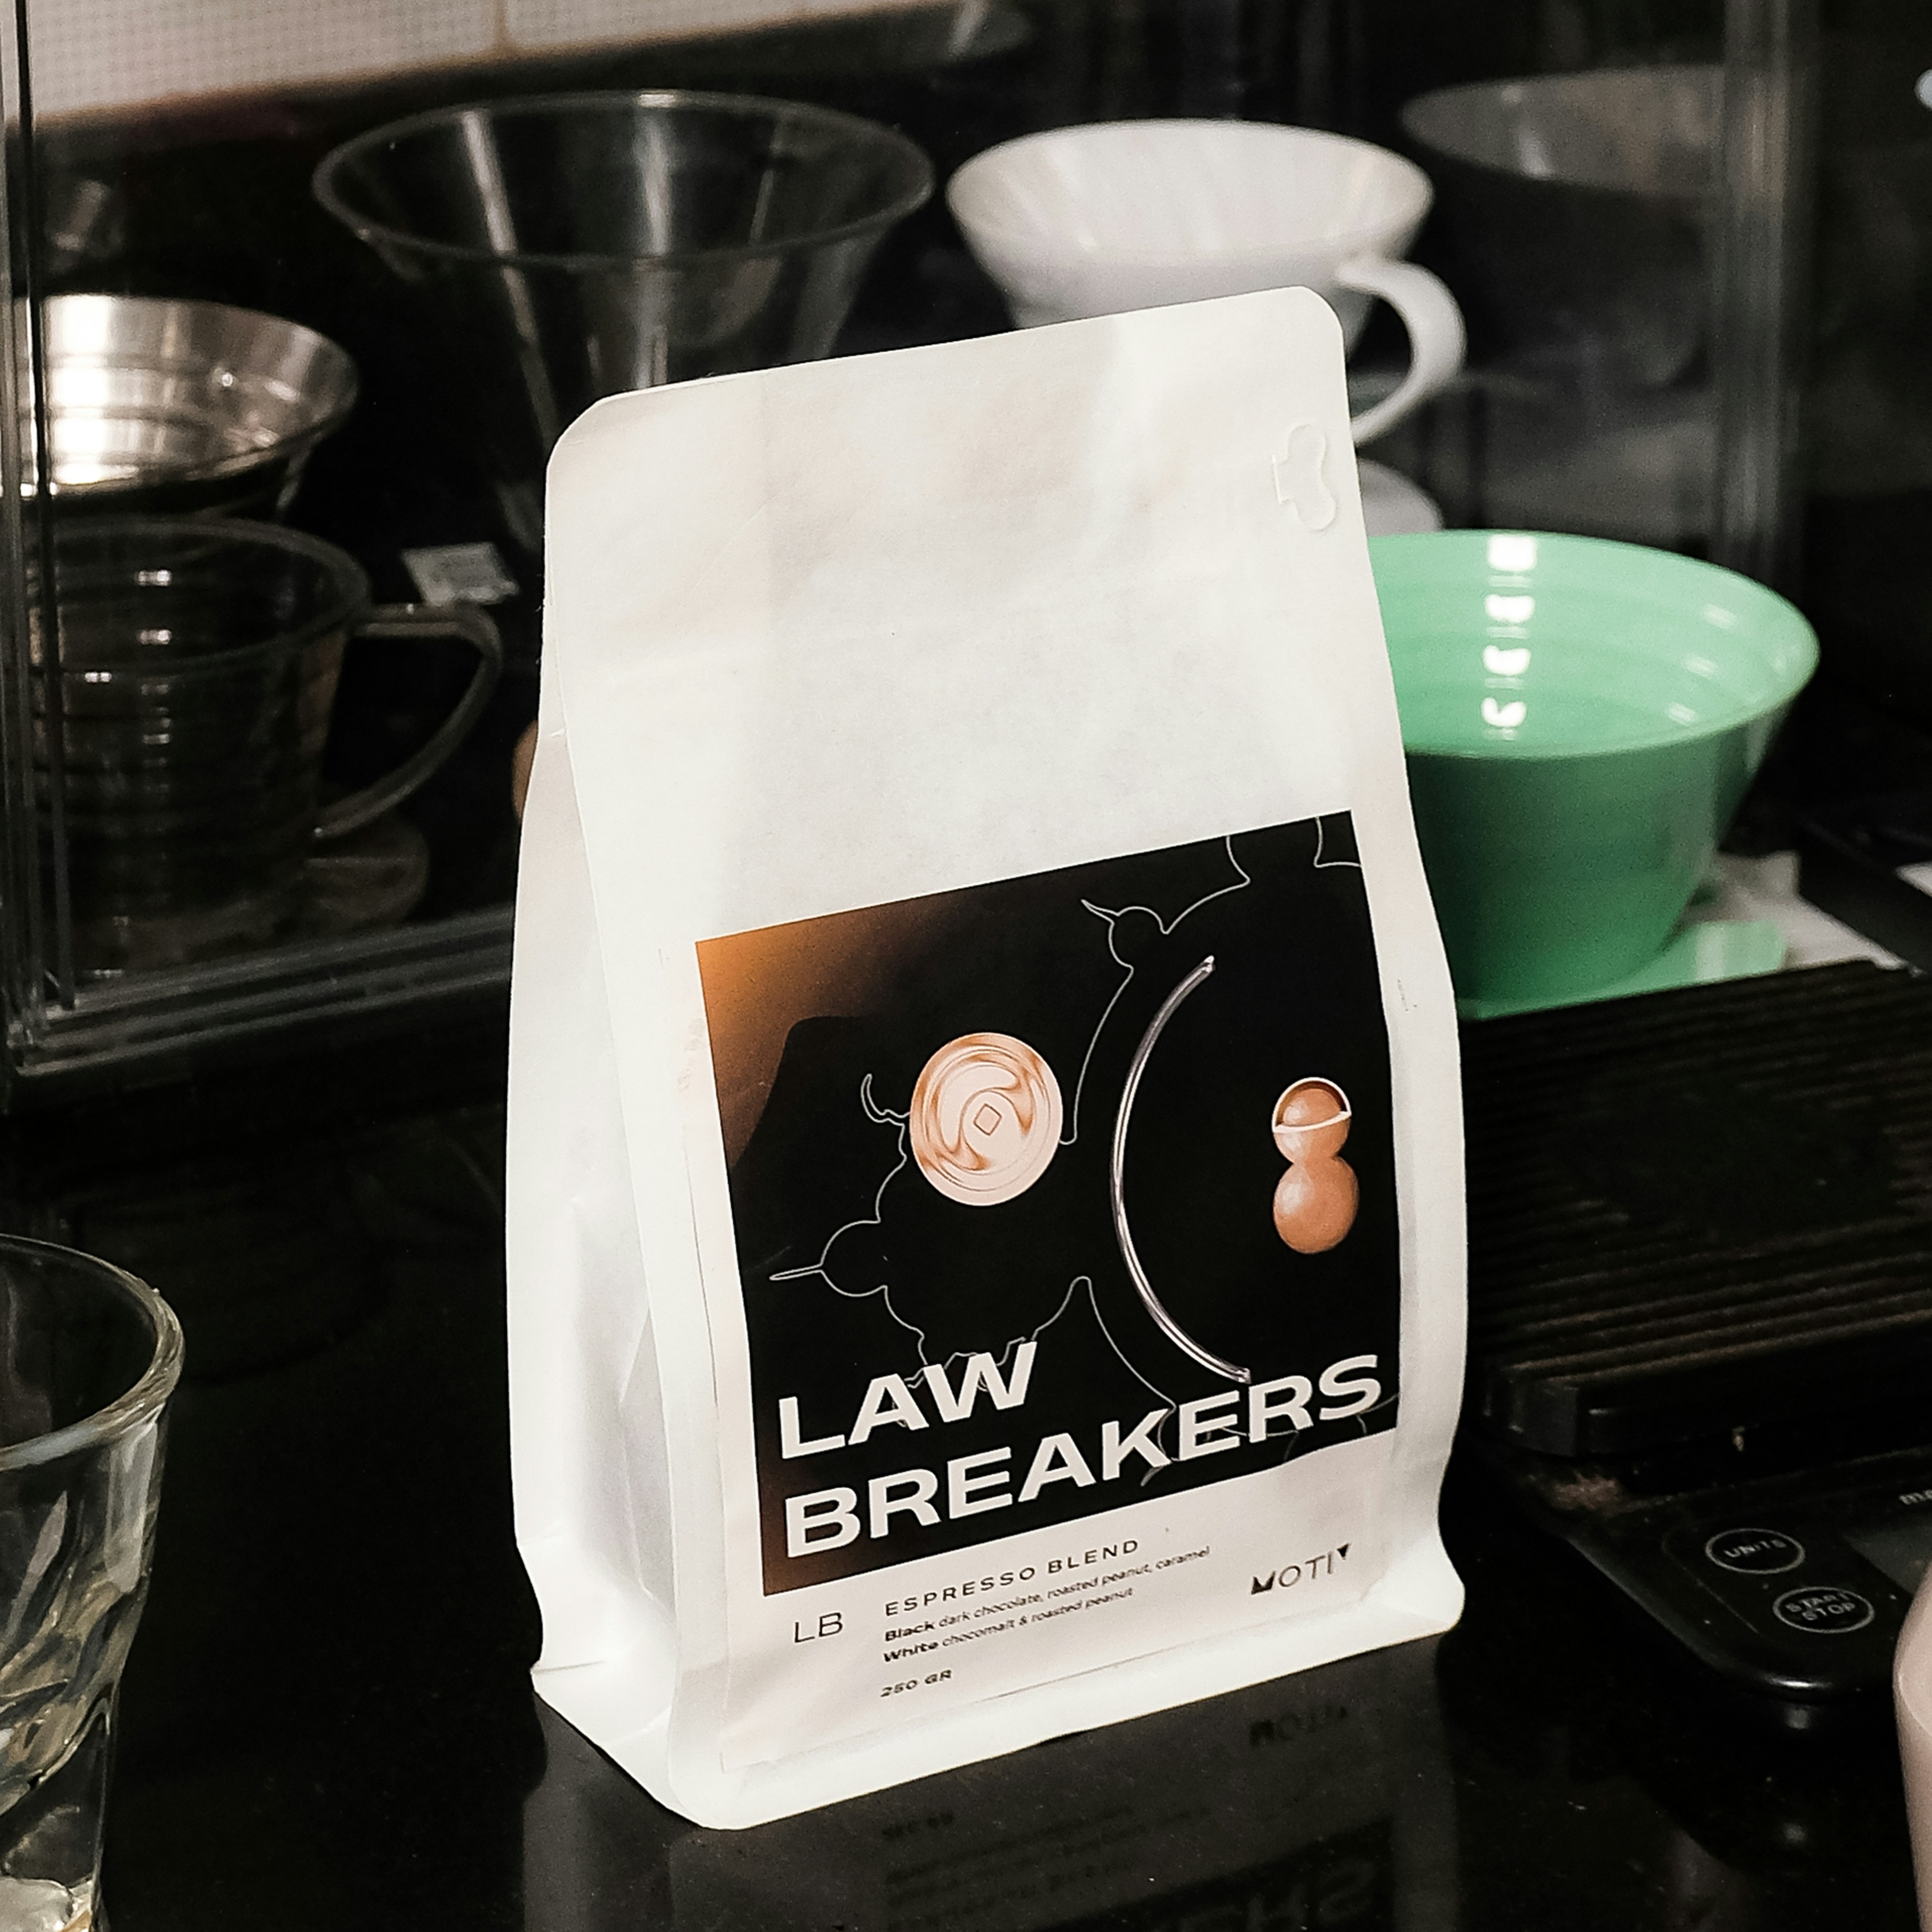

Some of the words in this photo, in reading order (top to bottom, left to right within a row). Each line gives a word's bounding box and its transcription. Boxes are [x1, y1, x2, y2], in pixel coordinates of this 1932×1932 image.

[779, 1341, 1037, 1461] LAW
[784, 1353, 1383, 1558] BREAKERS
[885, 1567, 1035, 1616] ESPRESSO
[1047, 1539, 1139, 1574] BLEND
[1723, 1539, 1786, 1558] UNITS
[794, 1612, 843, 1643] LB
[883, 1641, 939, 1662] White
[942, 1620, 1015, 1646] chocomalt
[1018, 1615, 1028, 1626] &
[1031, 1599, 1083, 1622] roasted
[1085, 1588, 1133, 1610] peanut
[885, 1621, 936, 1642] Black
[939, 1611, 971, 1628] dark
[1047, 1576, 1099, 1600] roasted
[1101, 1563, 1152, 1587] peanut,
[1155, 1545, 1210, 1570] caramel
[1801, 1602, 1855, 1621] STOP
[880, 1679, 918, 1697] 250
[924, 1669, 952, 1685] GR
